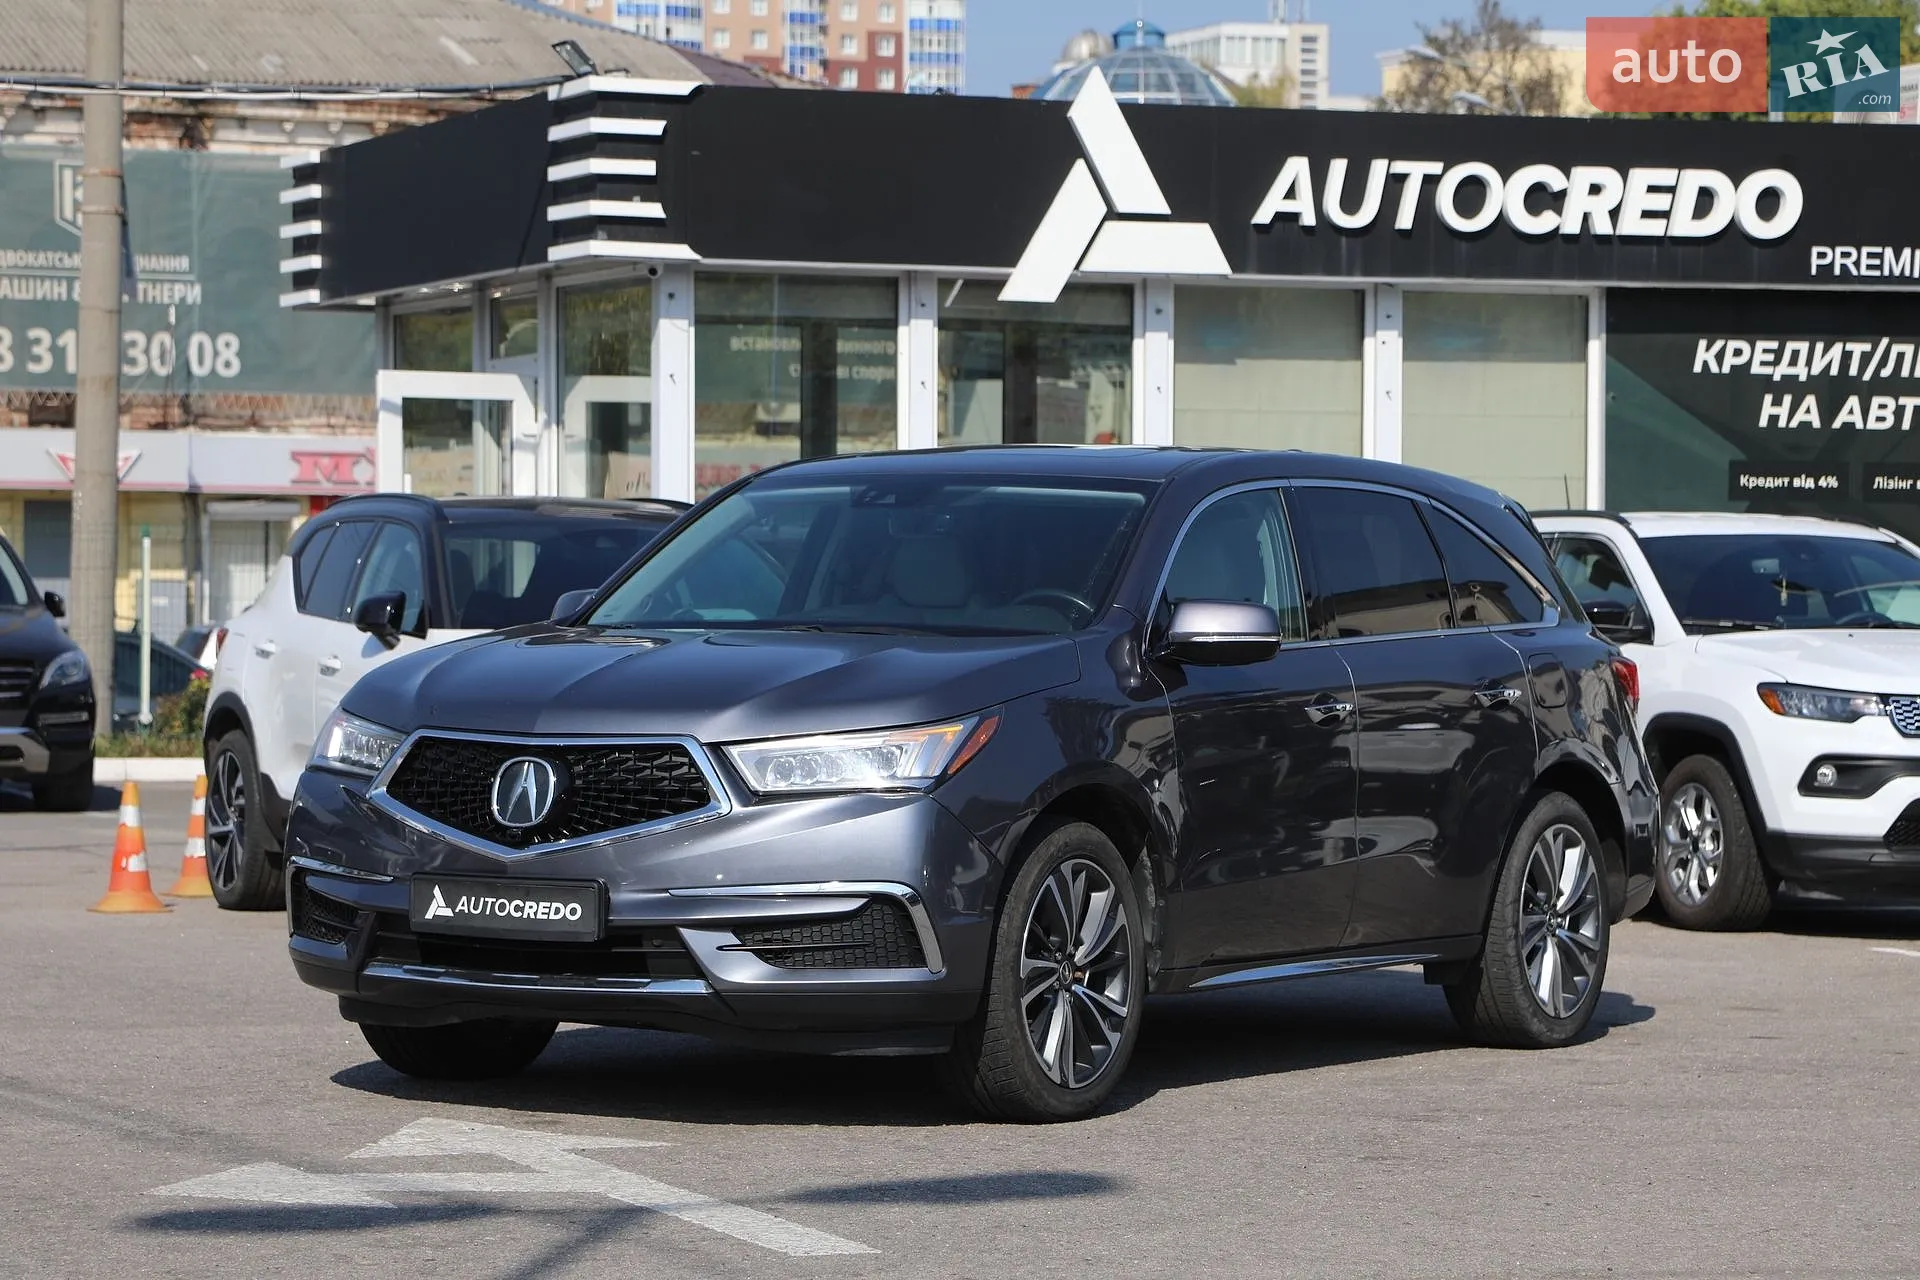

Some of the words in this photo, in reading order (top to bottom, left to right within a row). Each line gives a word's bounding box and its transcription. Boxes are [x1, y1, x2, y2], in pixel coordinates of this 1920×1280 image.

[1251, 156, 1803, 240] AUTOCREDO
[188, 332, 241, 377] 08
[1758, 394, 1821, 428] НА
[1739, 474, 1790, 489] Кредит
[1793, 472, 1816, 490] від
[1818, 475, 1839, 489] 4%
[455, 896, 582, 921] AUTOCREDO
